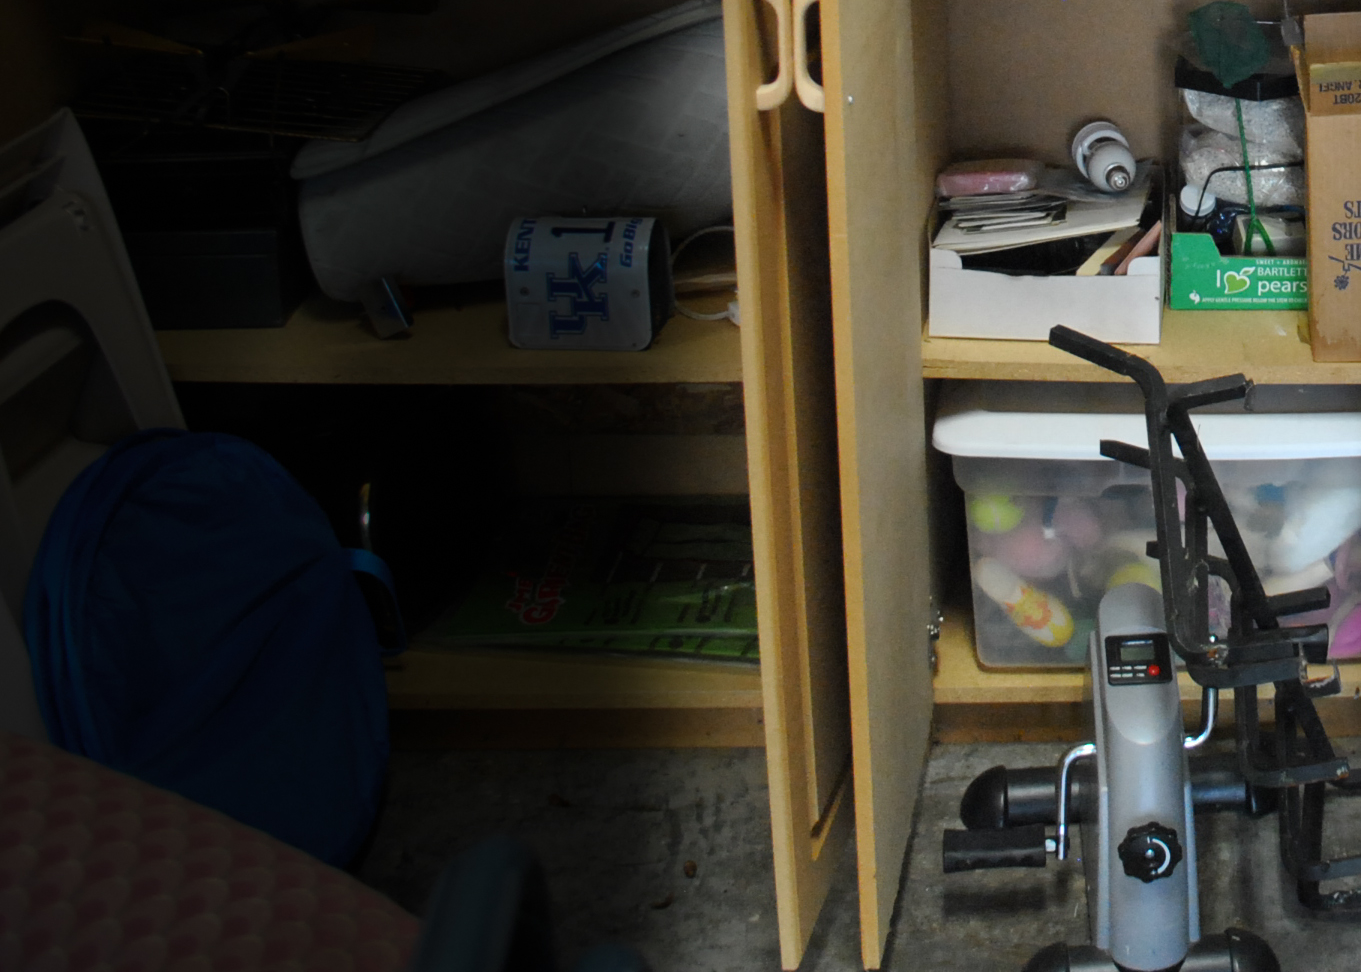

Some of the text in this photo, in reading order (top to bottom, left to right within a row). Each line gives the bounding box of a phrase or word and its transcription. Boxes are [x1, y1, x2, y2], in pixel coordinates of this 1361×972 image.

[1257, 267, 1308, 277] BARTLETT
[546, 252, 609, 340] UK
[1257, 279, 1308, 297] pears
